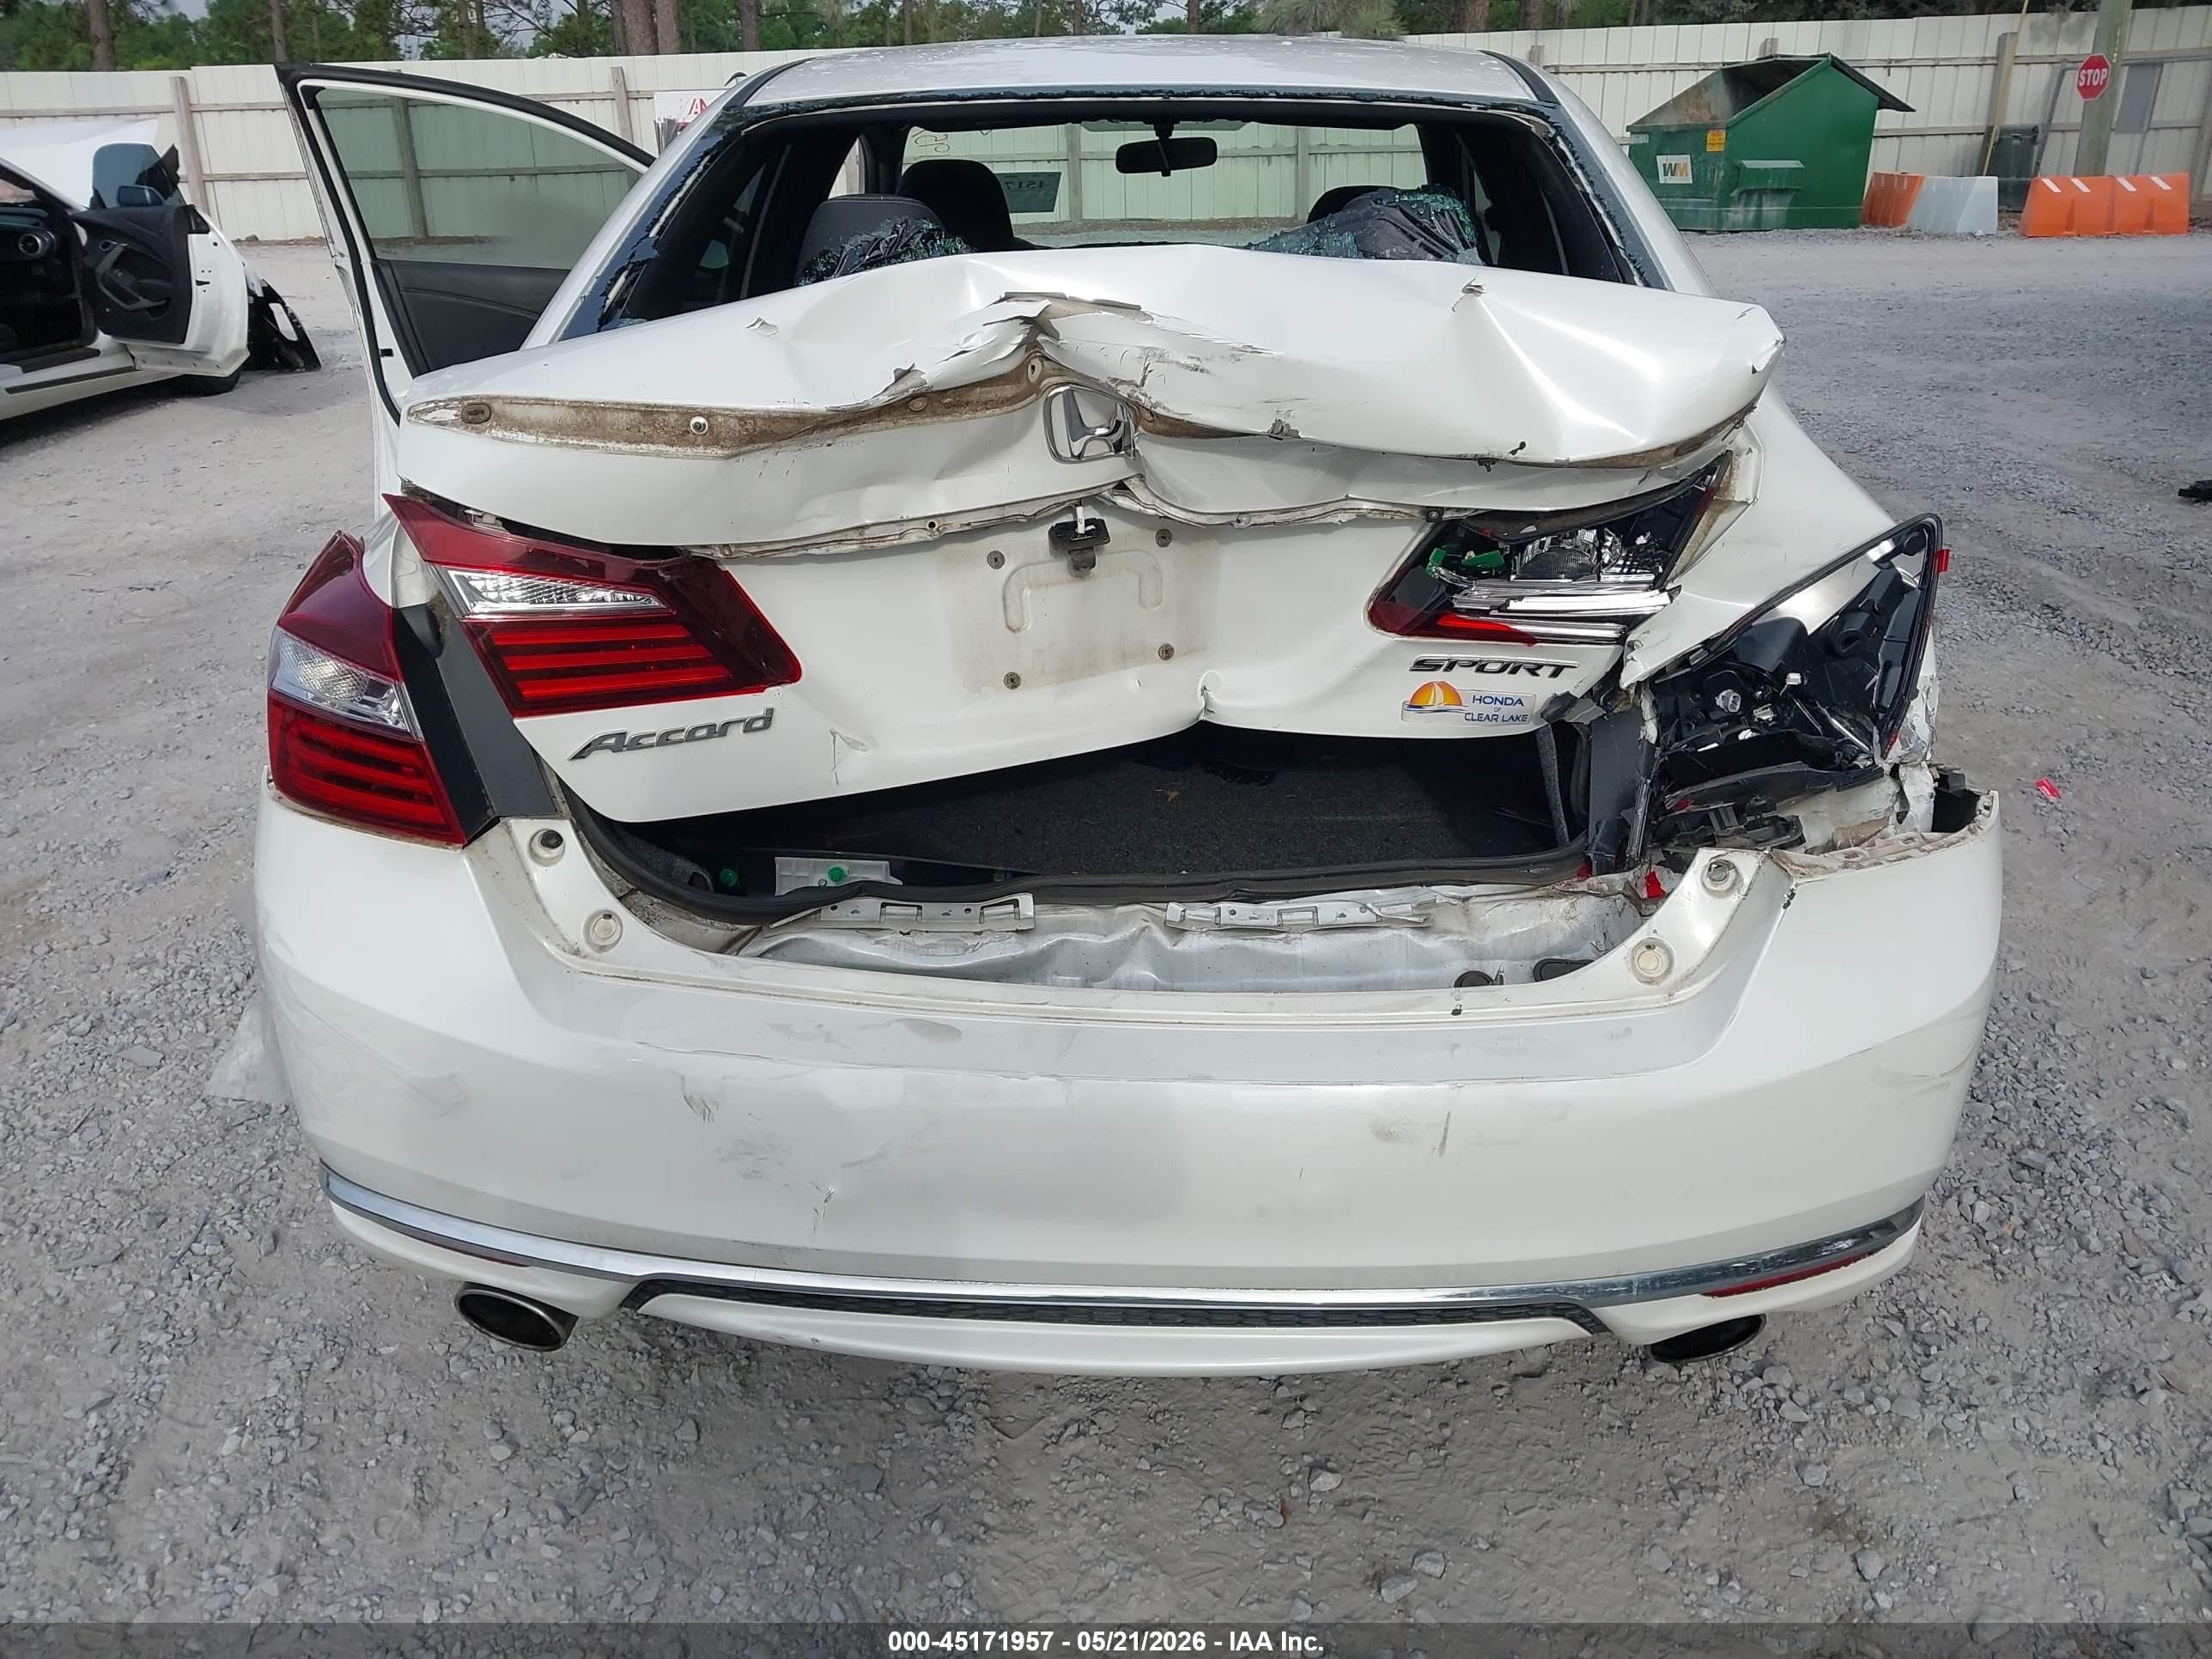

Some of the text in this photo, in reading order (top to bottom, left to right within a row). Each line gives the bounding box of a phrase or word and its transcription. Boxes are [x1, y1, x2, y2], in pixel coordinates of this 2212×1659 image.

[2079, 68, 2108, 87] STOP
[1662, 162, 1689, 177] WM
[1409, 655, 1579, 678] SPORT
[1472, 695, 1525, 708] HONDA
[1464, 713, 1528, 723] CLEAR LAKE
[567, 707, 775, 761] Accord
